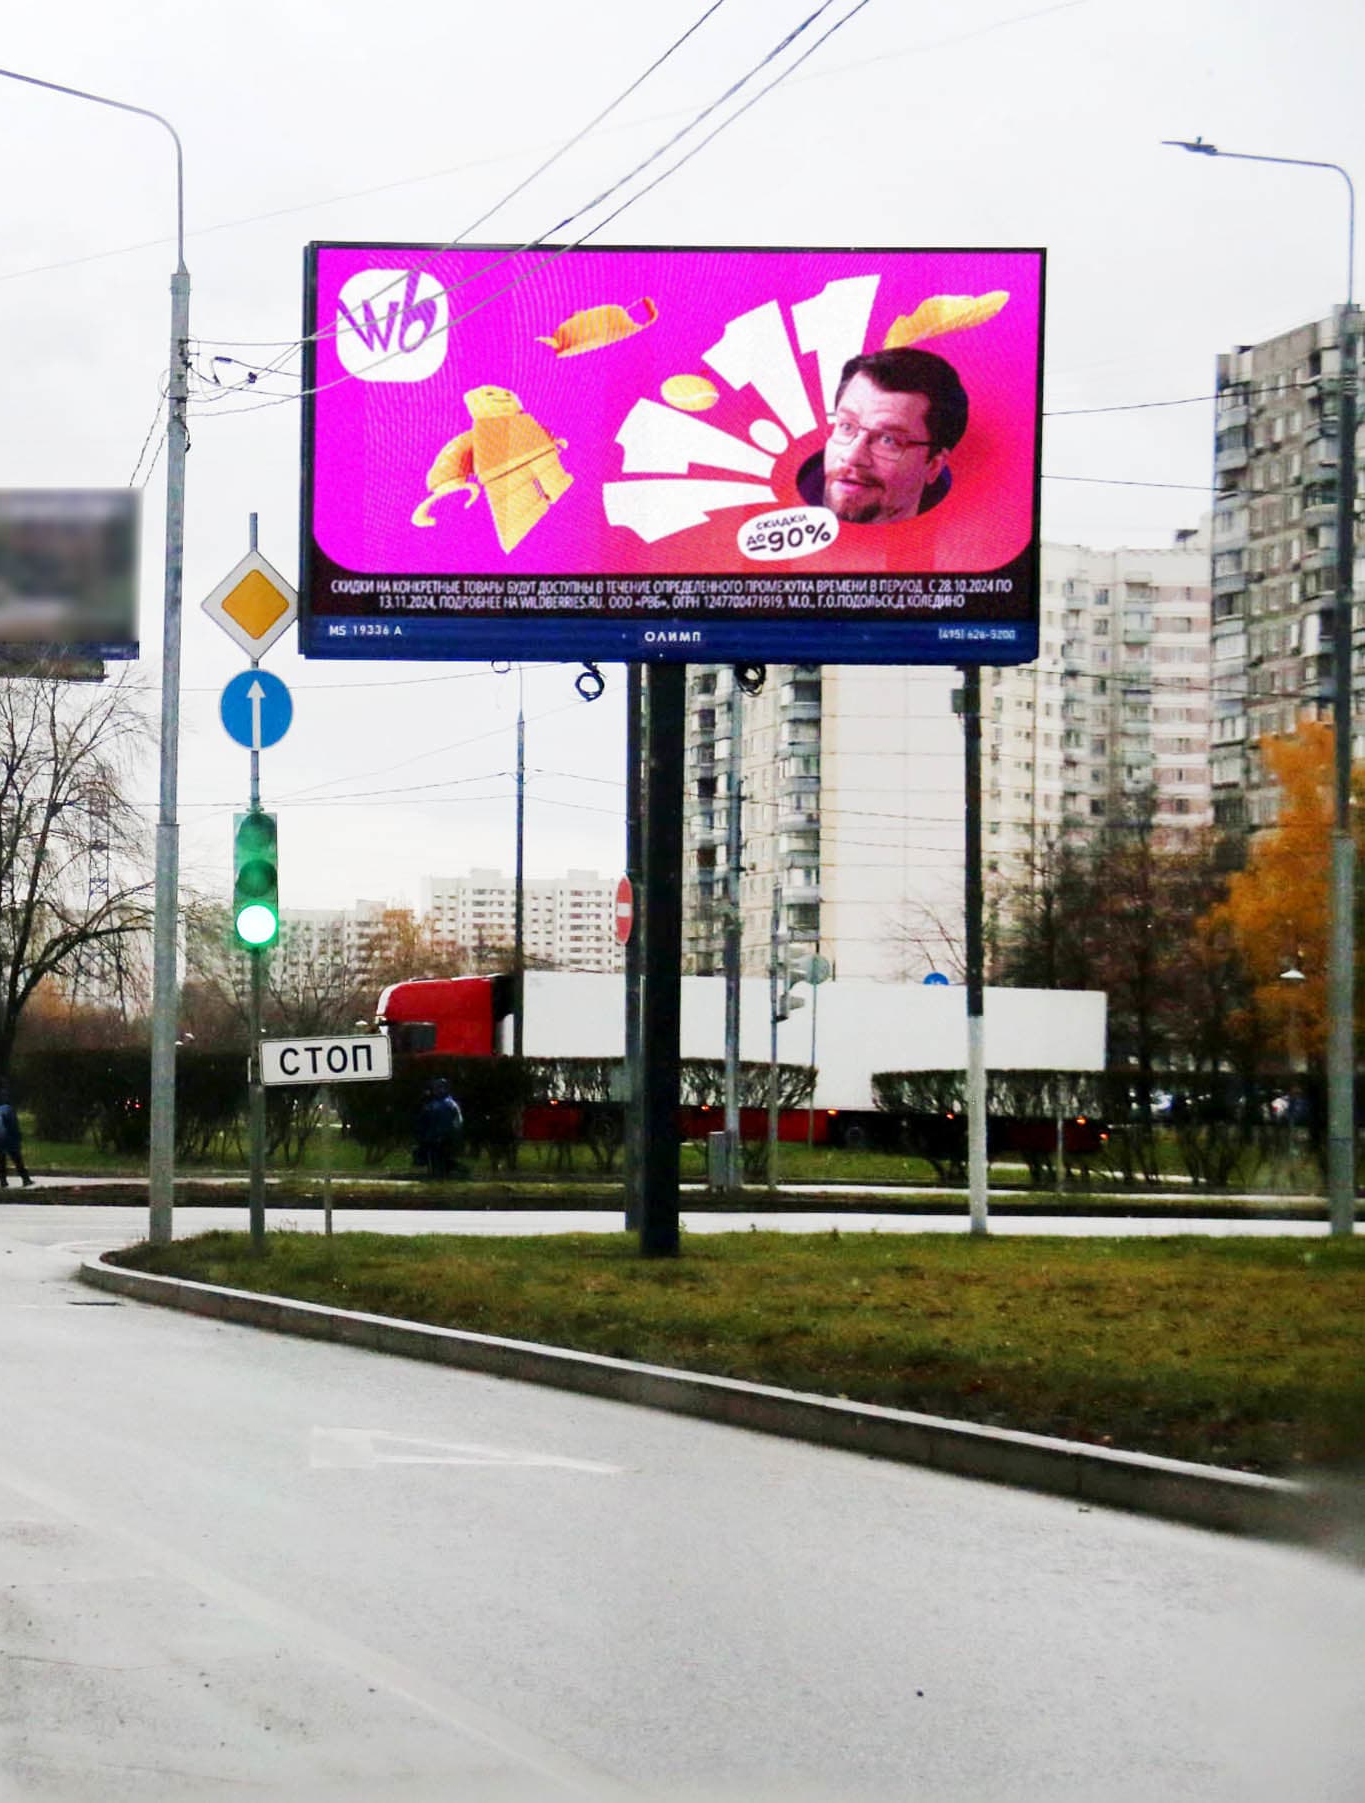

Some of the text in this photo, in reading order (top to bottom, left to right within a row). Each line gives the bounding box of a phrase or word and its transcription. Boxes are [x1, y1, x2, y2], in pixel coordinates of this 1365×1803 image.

[767, 521, 832, 552] 90%
[330, 579, 1013, 595] СКИДКИ НА КОНКРЕТНЫЕ ТОВАРЫ БУДУТ ДОСТУПНЫ В ТЕЧЕНИЕ ОПРЕДЕЛЕННОГО ПРОМЕЖУТКА ВРЕМЕНИ В ПЕРИОД С 28.10.2024 ПО
[439, 594, 501, 609] ПОДРОБНЕЕ
[503, 594, 519, 609] НА
[608, 594, 633, 609] ООО
[672, 594, 700, 608] ОГРН
[329, 624, 346, 636] MS
[353, 624, 390, 636] 19336
[644, 631, 701, 642] ОЛИМП
[279, 1044, 372, 1076] СТОП
